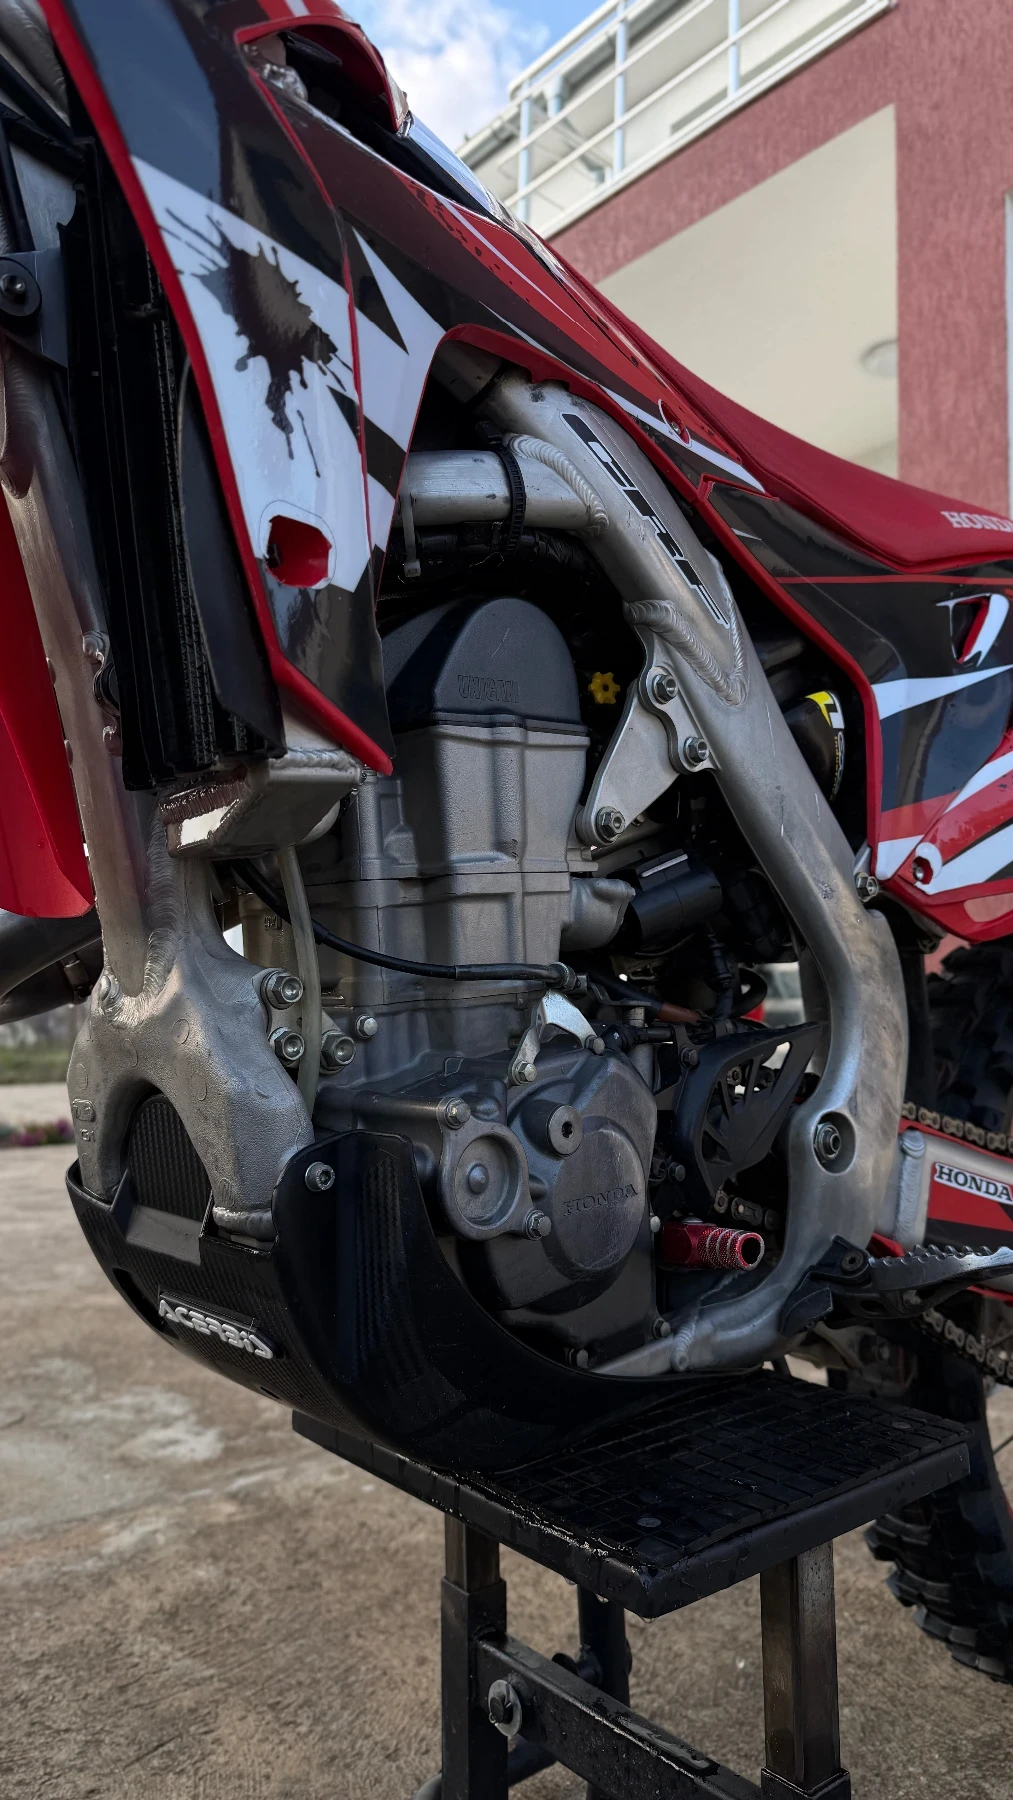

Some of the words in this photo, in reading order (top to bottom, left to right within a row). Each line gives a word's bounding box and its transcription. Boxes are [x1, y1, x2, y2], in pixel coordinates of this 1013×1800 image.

[561, 412, 729, 628] CRF
[563, 1184, 638, 1217] HONDA
[936, 1164, 1012, 1202] HONDA
